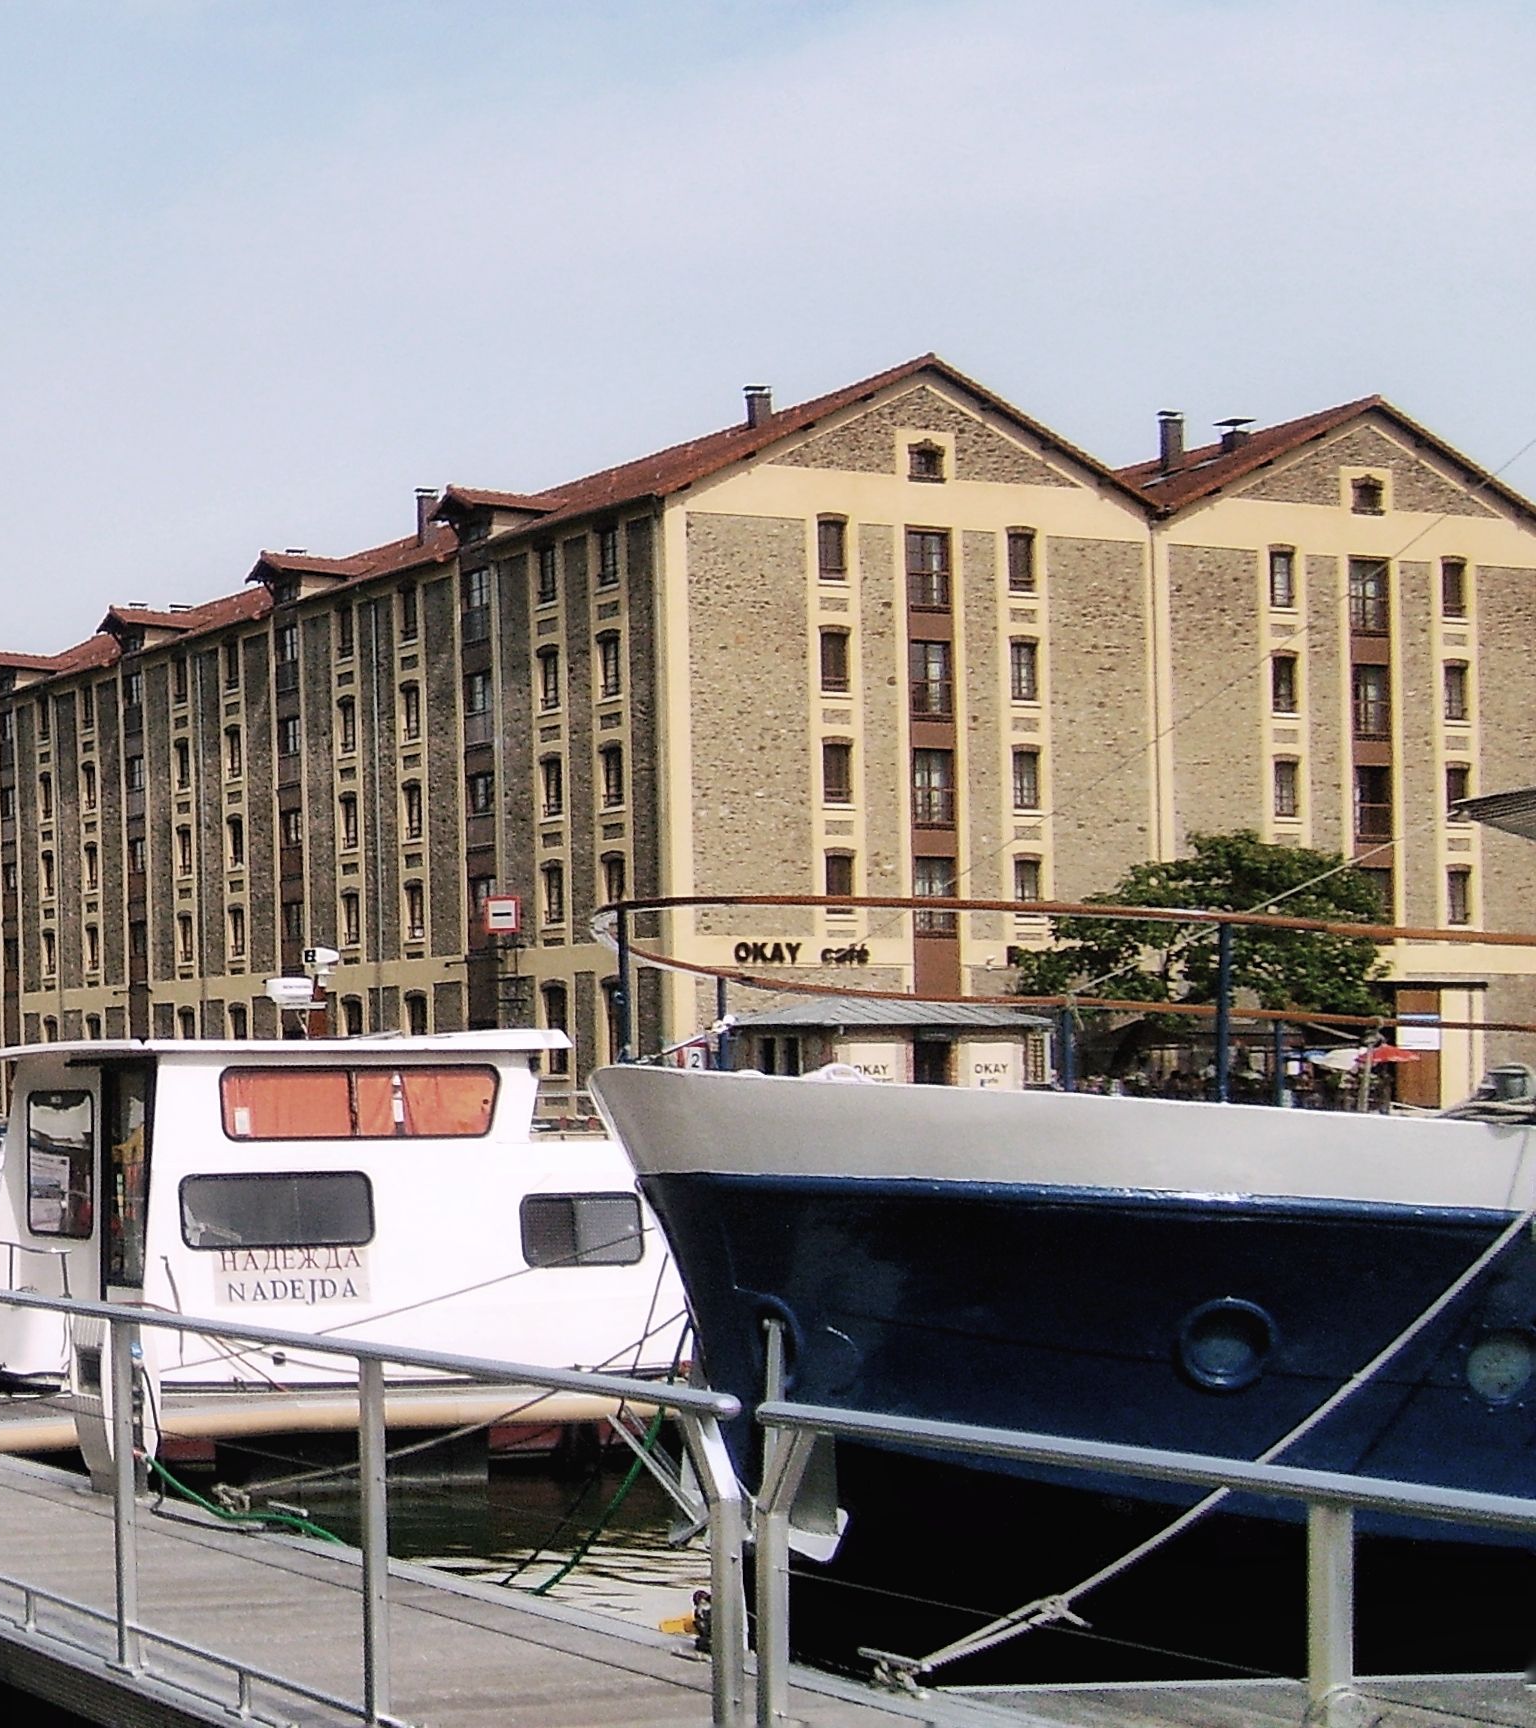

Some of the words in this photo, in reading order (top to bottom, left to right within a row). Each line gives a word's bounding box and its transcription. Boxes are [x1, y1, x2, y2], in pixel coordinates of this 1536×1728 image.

[734, 942, 803, 964] OKAY
[691, 1053, 700, 1068] 2
[974, 1063, 1008, 1075] OKAY
[220, 1247, 362, 1274] НАДЕЖДА
[228, 1278, 358, 1305] NADEJDA
